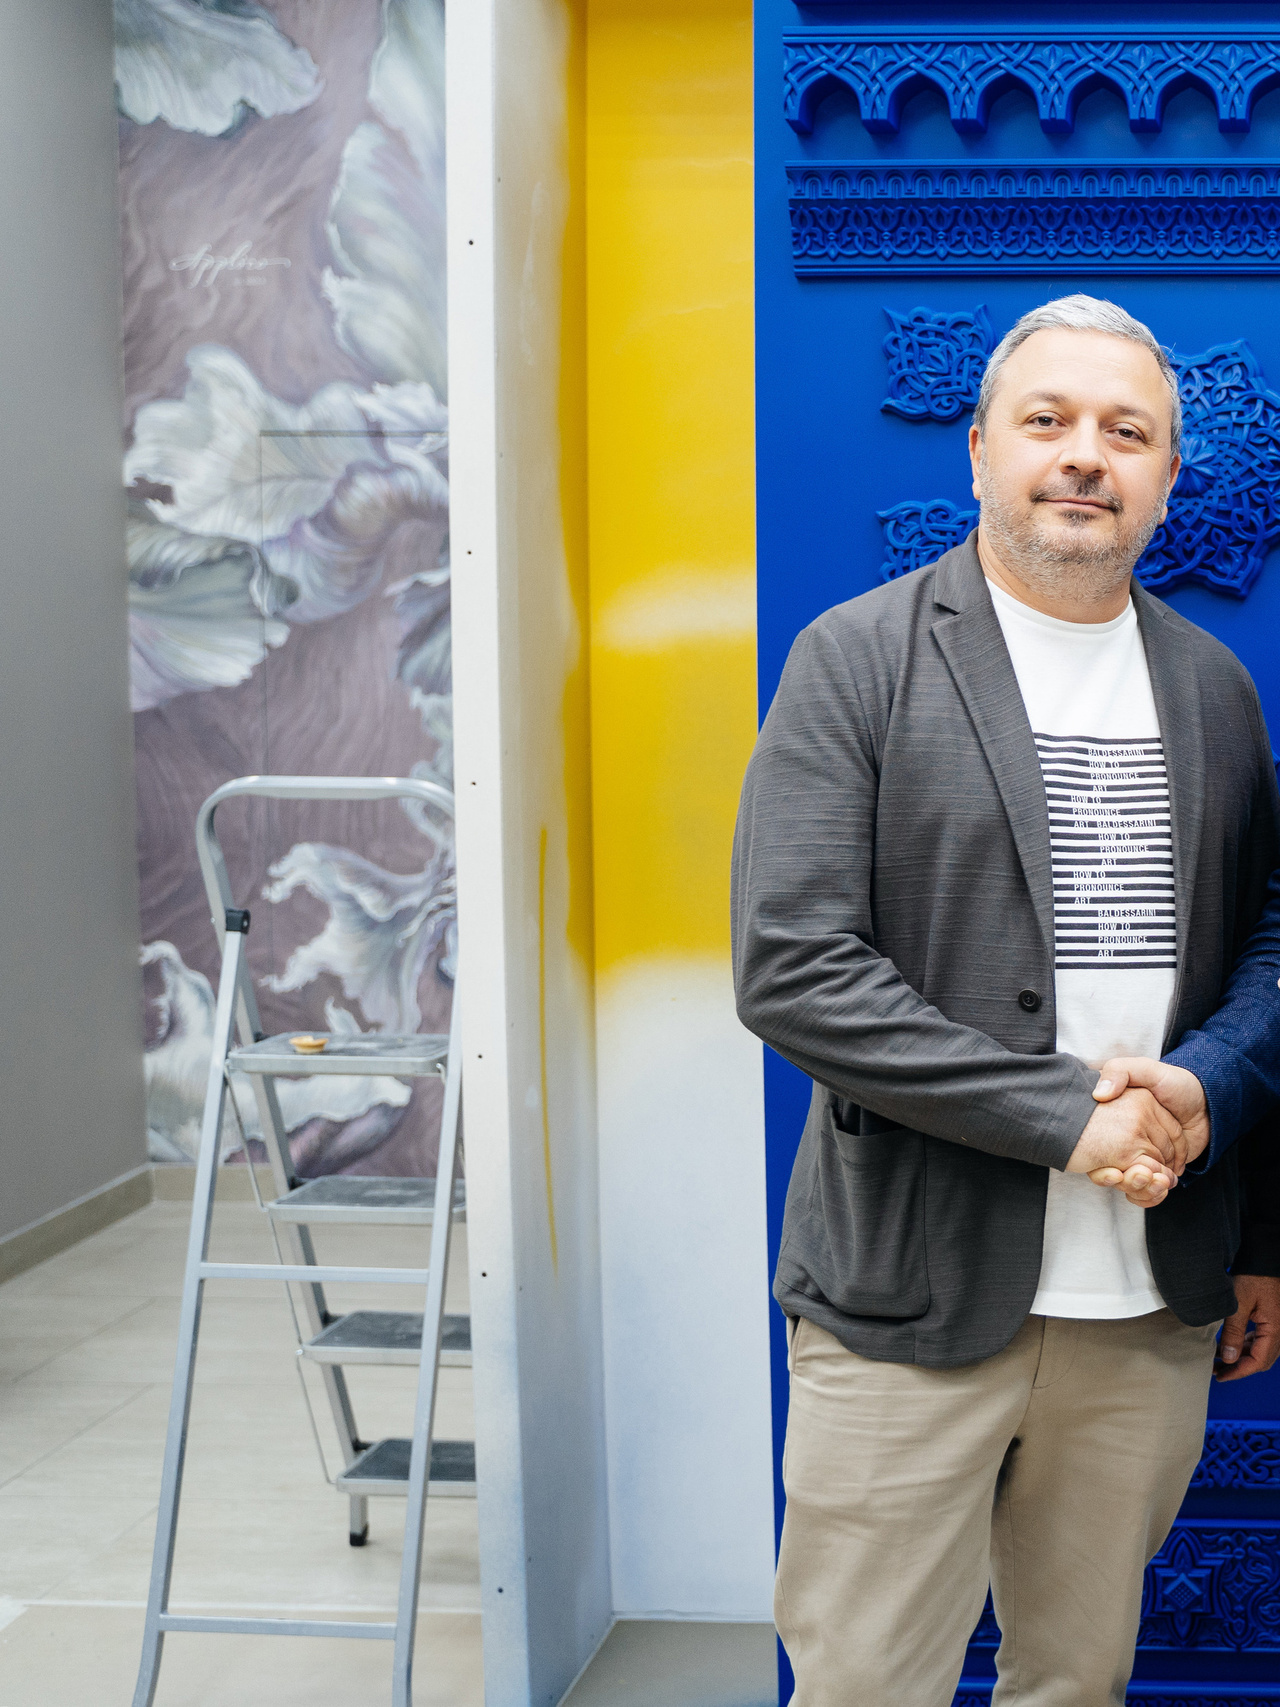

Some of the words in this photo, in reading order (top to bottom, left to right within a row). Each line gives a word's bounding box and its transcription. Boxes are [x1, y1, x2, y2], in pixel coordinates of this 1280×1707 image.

[1073, 808, 1121, 816] PRONOUNCE
[1097, 820, 1156, 828] BALDESSARINI
[1098, 909, 1156, 917] BALDESSARINI
